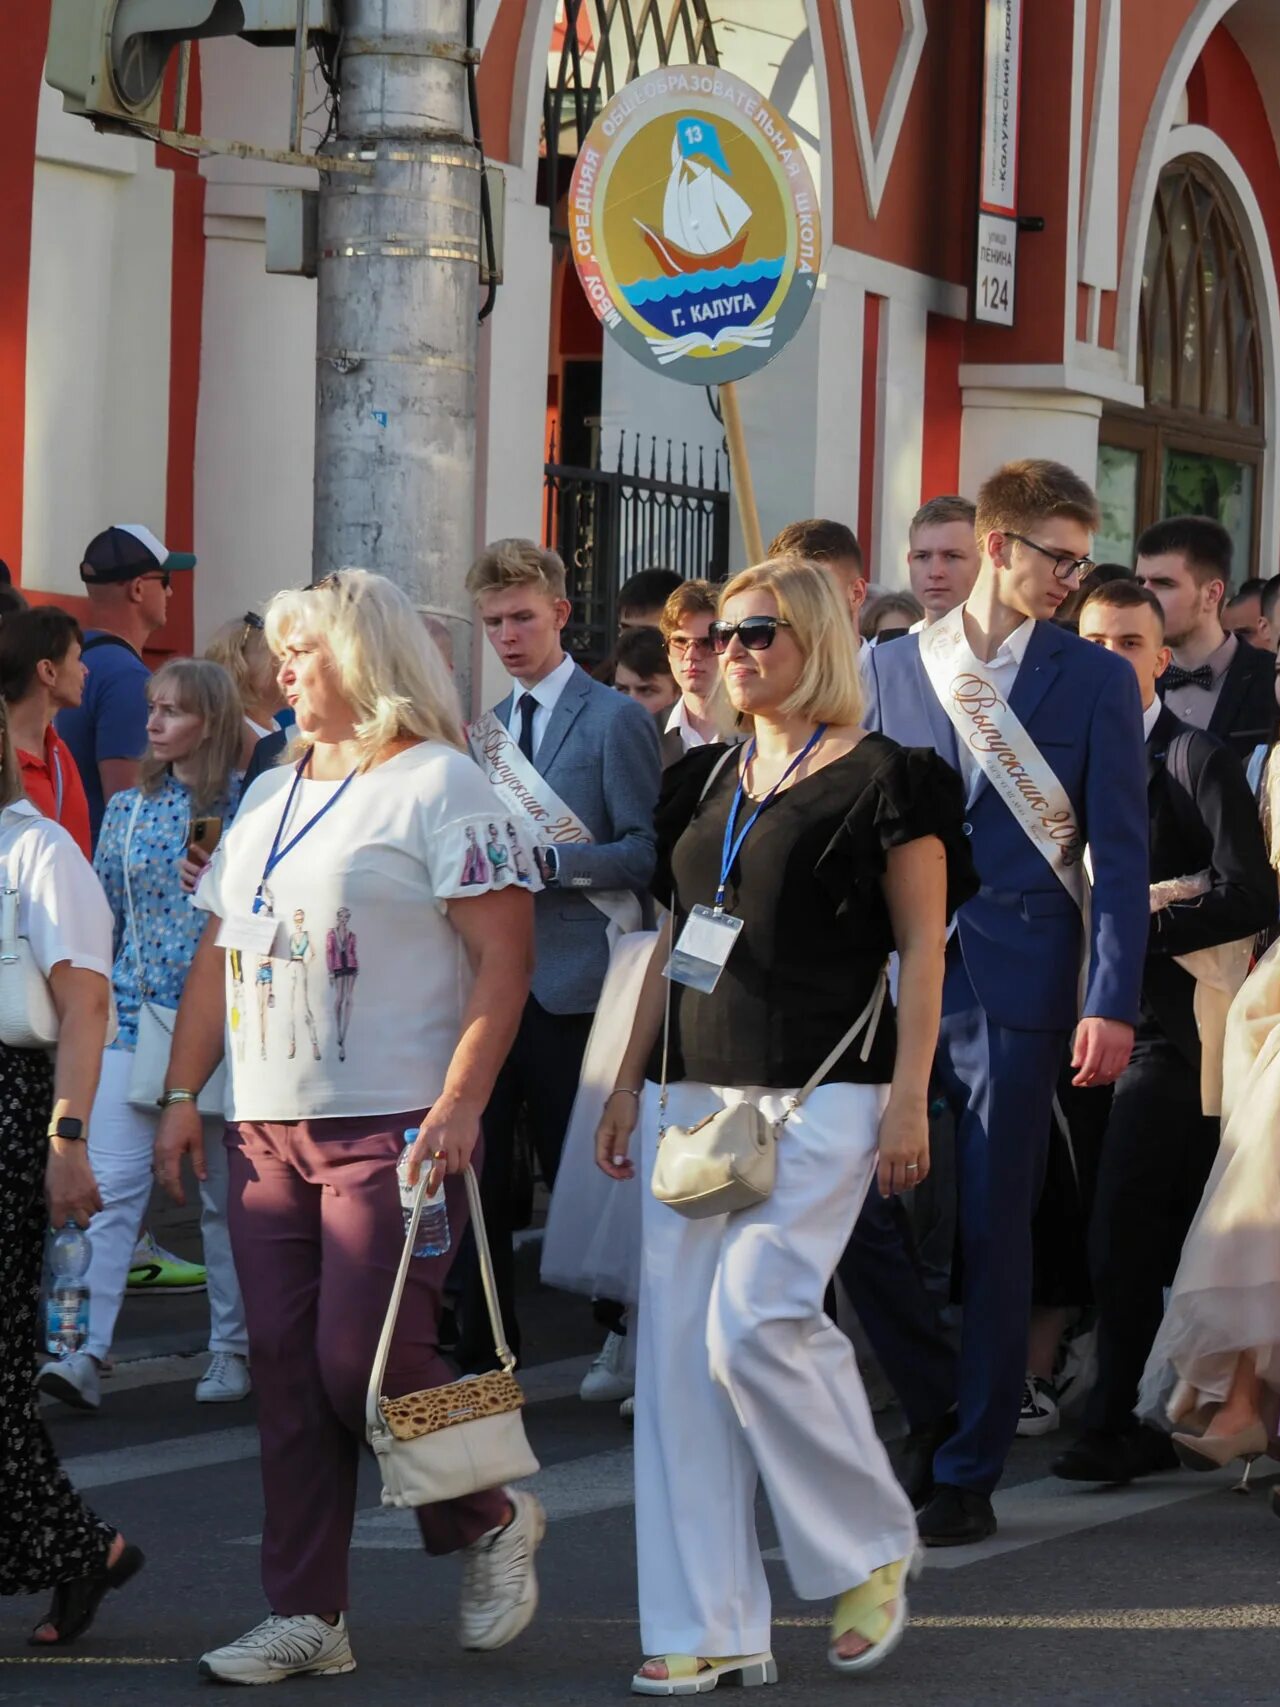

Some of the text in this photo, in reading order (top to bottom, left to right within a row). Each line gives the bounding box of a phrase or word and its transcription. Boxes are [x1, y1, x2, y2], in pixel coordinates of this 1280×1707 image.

[602, 73, 800, 177] ОБЩЕОБРАЗОВАТЕЛЬНАЯ
[684, 125, 703, 144] 13
[980, 246, 1012, 267] ЛЕНИНА
[585, 275, 622, 330] МБОУ
[671, 293, 756, 327] Г. КАЛУГА
[981, 275, 1009, 312] 124
[484, 730, 550, 821] Выпускник
[950, 673, 1050, 811] Выпускник
[1038, 811, 1082, 867] 2023
